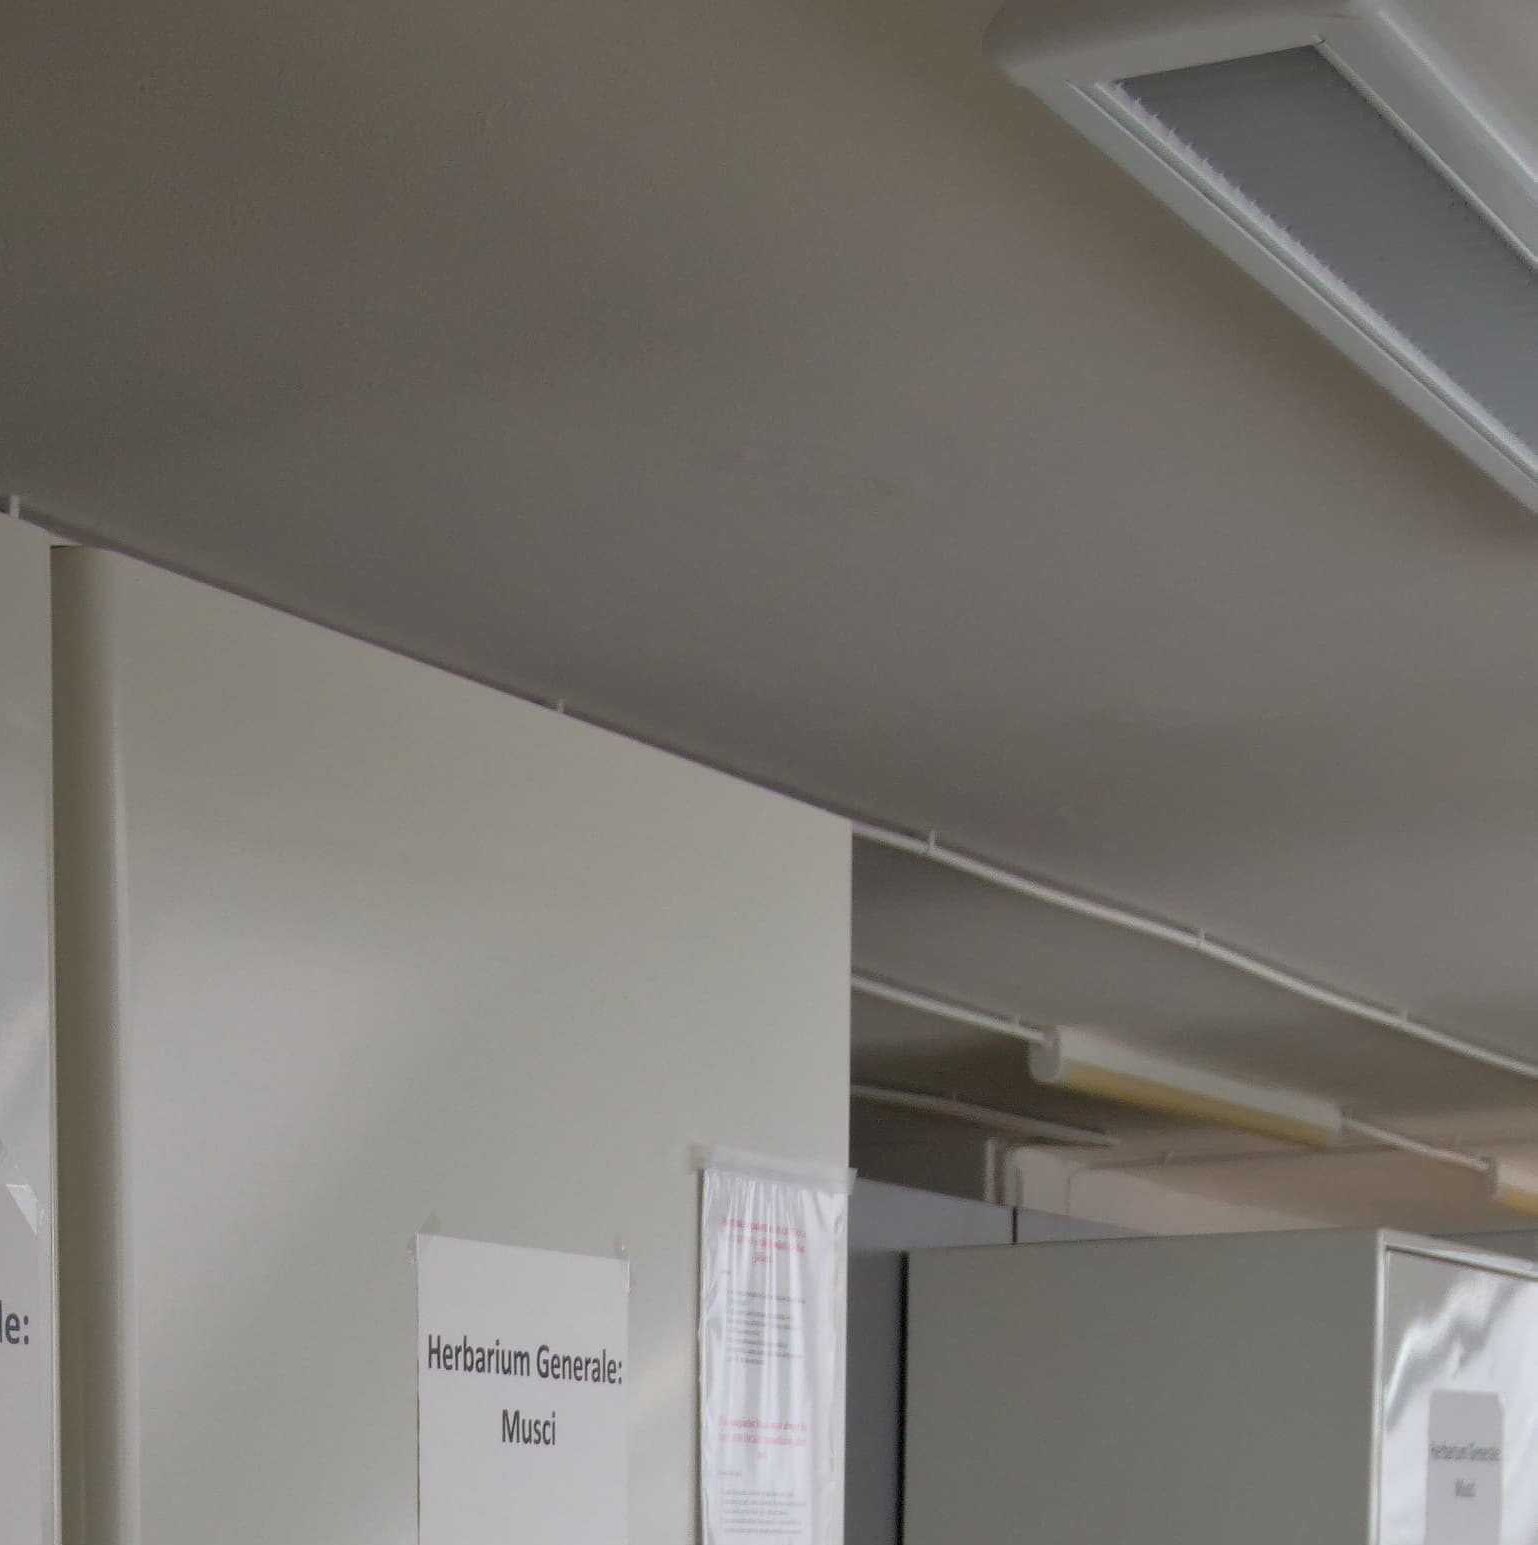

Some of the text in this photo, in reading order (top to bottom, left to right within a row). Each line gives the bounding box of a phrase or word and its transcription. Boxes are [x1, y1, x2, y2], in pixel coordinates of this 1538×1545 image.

[428, 1334, 623, 1385] Herbarium Generale:
[502, 1409, 556, 1446] Musci
